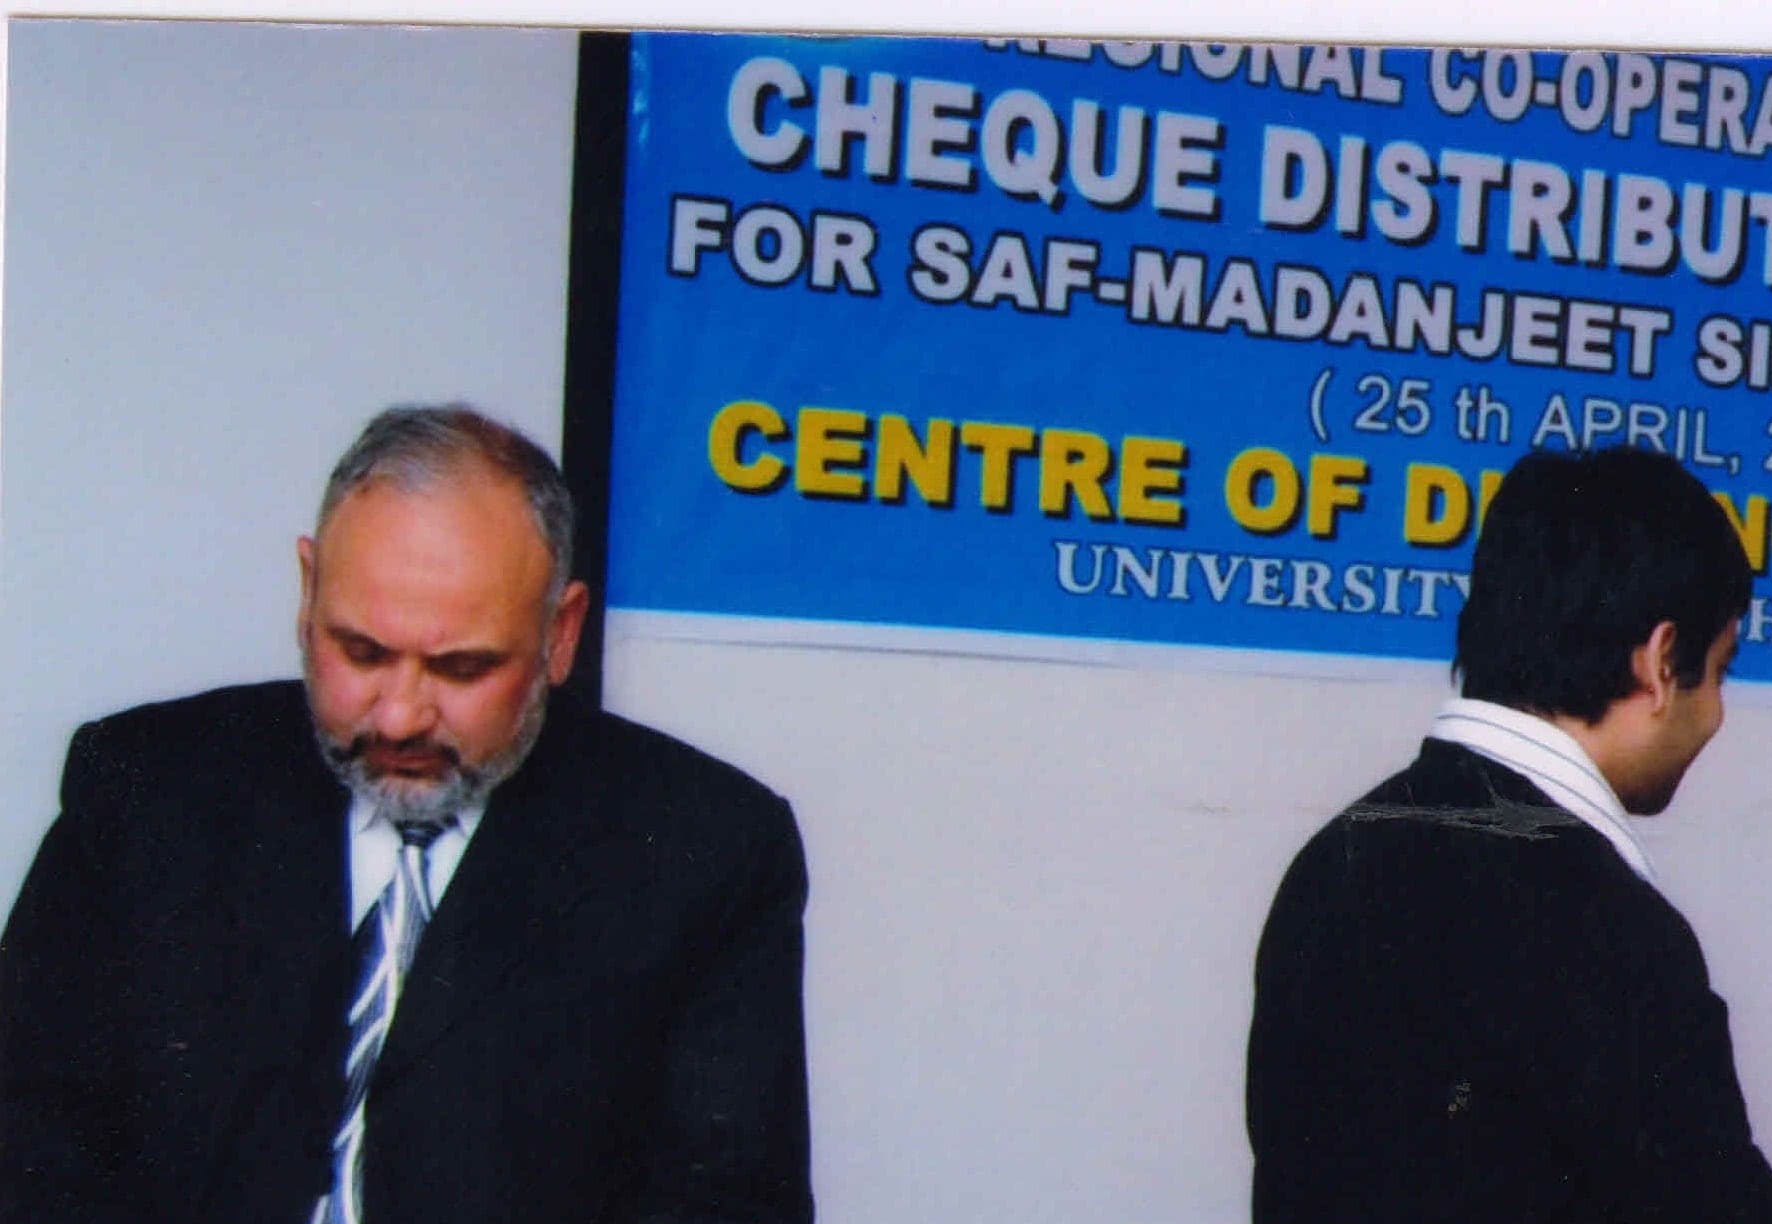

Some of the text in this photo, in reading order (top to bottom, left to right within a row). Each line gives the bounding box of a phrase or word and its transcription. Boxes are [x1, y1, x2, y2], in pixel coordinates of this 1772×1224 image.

[729, 59, 1217, 213] CHEQUE
[673, 201, 873, 289] FOR
[913, 229, 1668, 372] SAF-MADANJEET
[710, 402, 1183, 521] CENTRE
[1226, 449, 1364, 533] OF
[1355, 376, 1430, 434] 25
[1456, 388, 1508, 442] th
[1534, 395, 1738, 471] APRIL,
